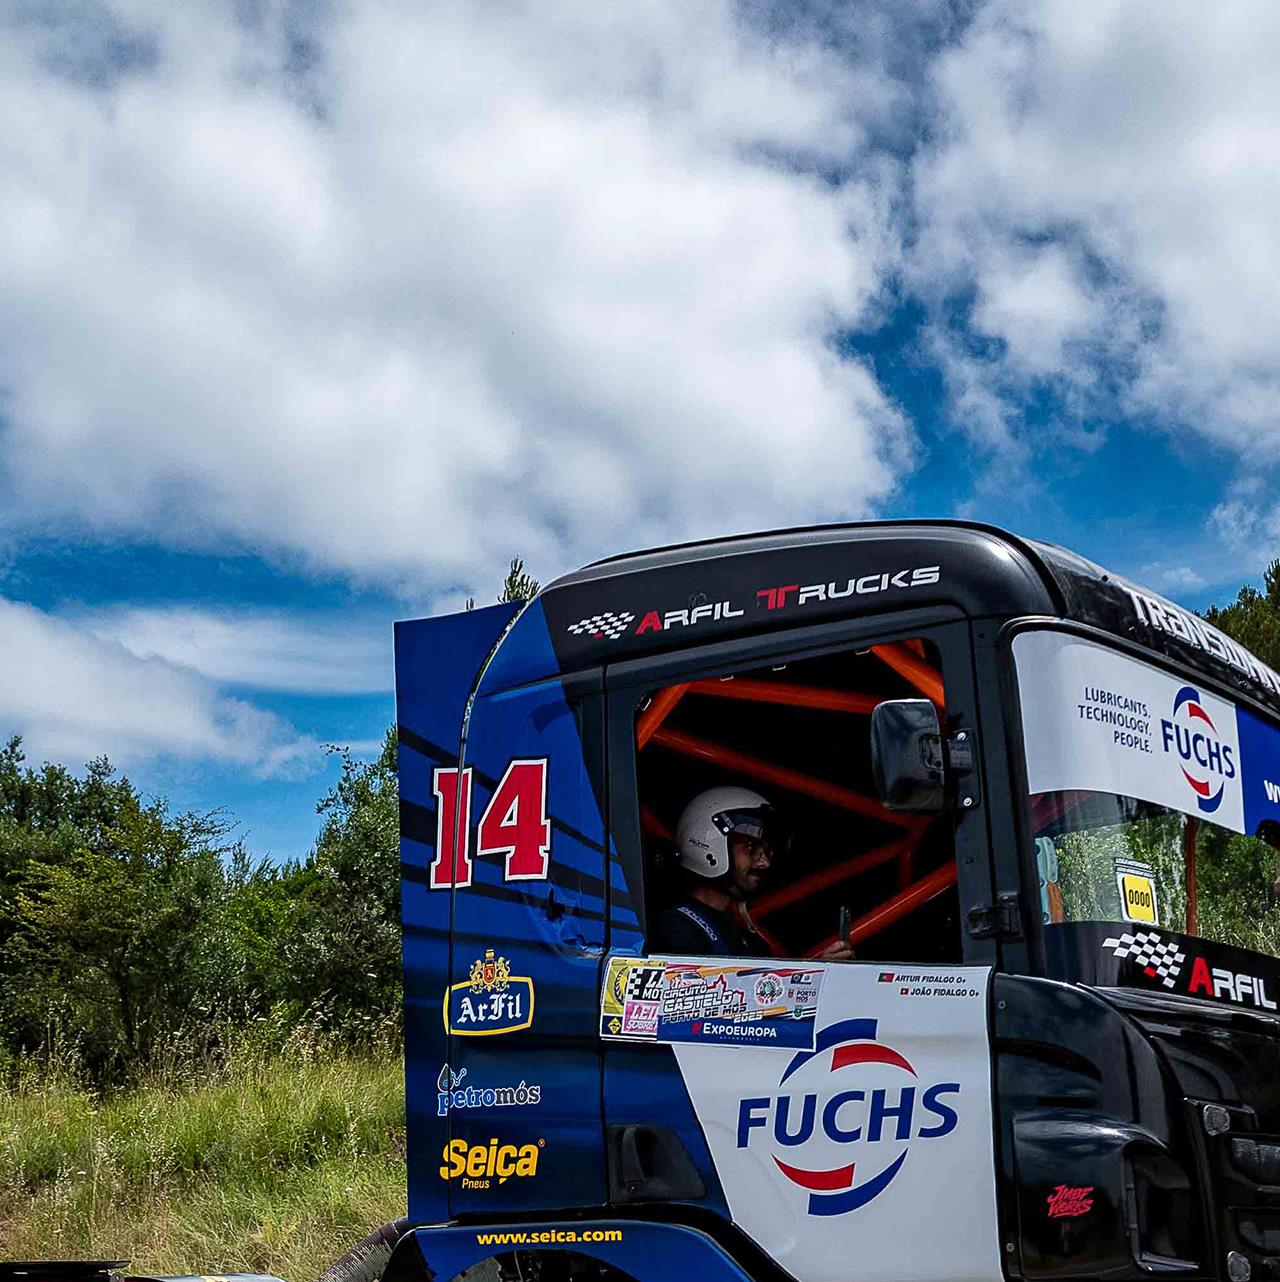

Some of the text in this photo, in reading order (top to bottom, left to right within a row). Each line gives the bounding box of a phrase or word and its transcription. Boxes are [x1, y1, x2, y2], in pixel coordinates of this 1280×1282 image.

[1161, 718, 1235, 779] FUCHS
[430, 758, 551, 889] 14
[921, 975, 955, 983] FIDALGO
[1188, 957, 1277, 1009] ARFIL
[663, 985, 707, 1000] CIRCUITO
[663, 990, 734, 1013] CASTELO
[910, 987, 932, 996] JOÃO
[933, 988, 967, 996] FIDALGO
[457, 993, 522, 1023] ArFil
[662, 1009, 701, 1024] PORTO
[704, 1006, 719, 1018] DE
[737, 1083, 961, 1149] FUCHS
[462, 1178, 490, 1189] Pneus
[477, 1229, 623, 1245] www.seica.com
